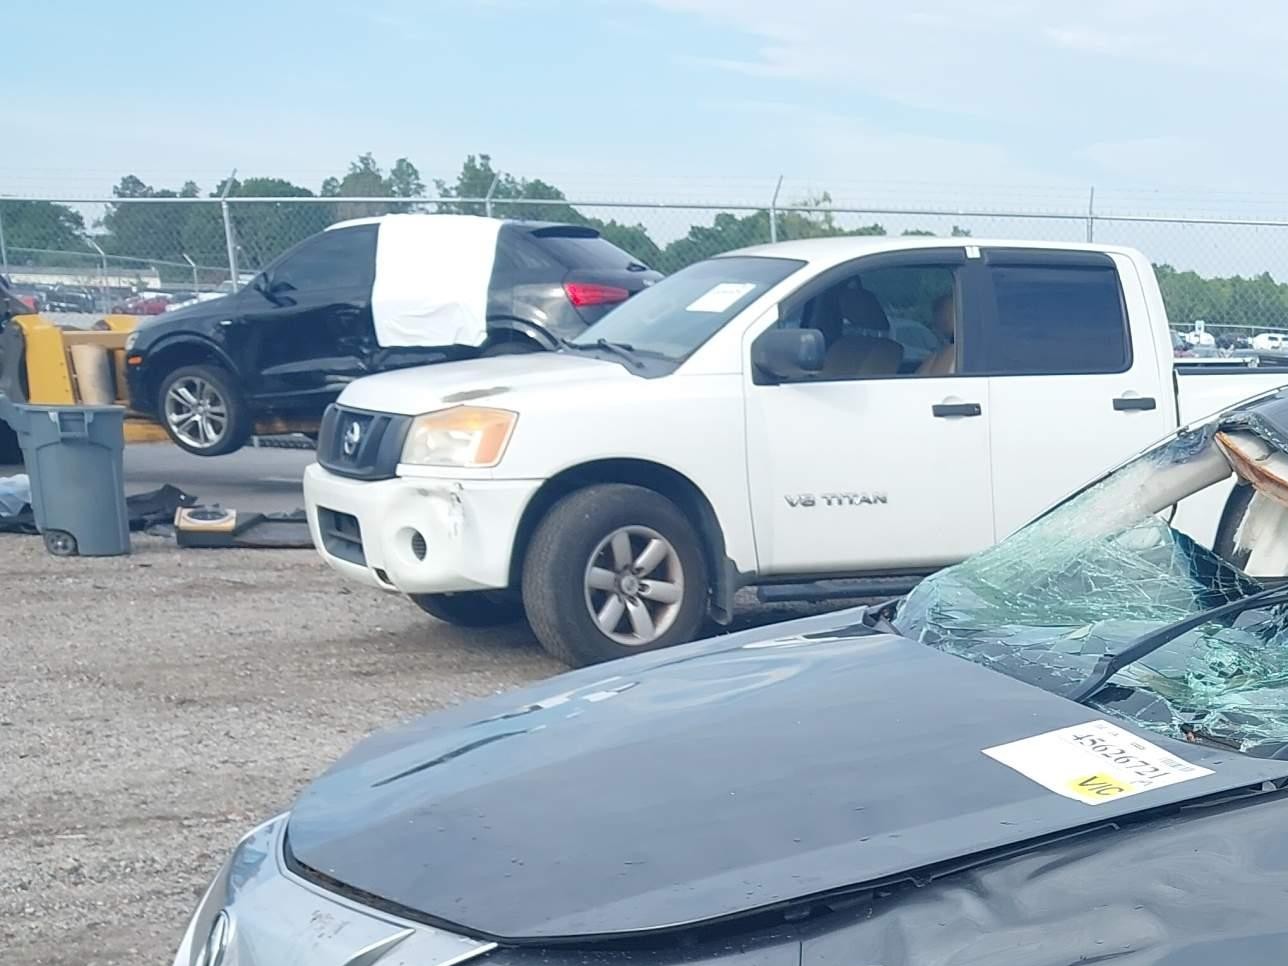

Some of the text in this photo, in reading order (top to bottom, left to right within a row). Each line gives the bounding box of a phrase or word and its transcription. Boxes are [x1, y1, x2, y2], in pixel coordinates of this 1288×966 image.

[821, 493, 888, 506] TITAN
[1071, 733, 1171, 780] 45626721
[1077, 775, 1125, 796] VIC
